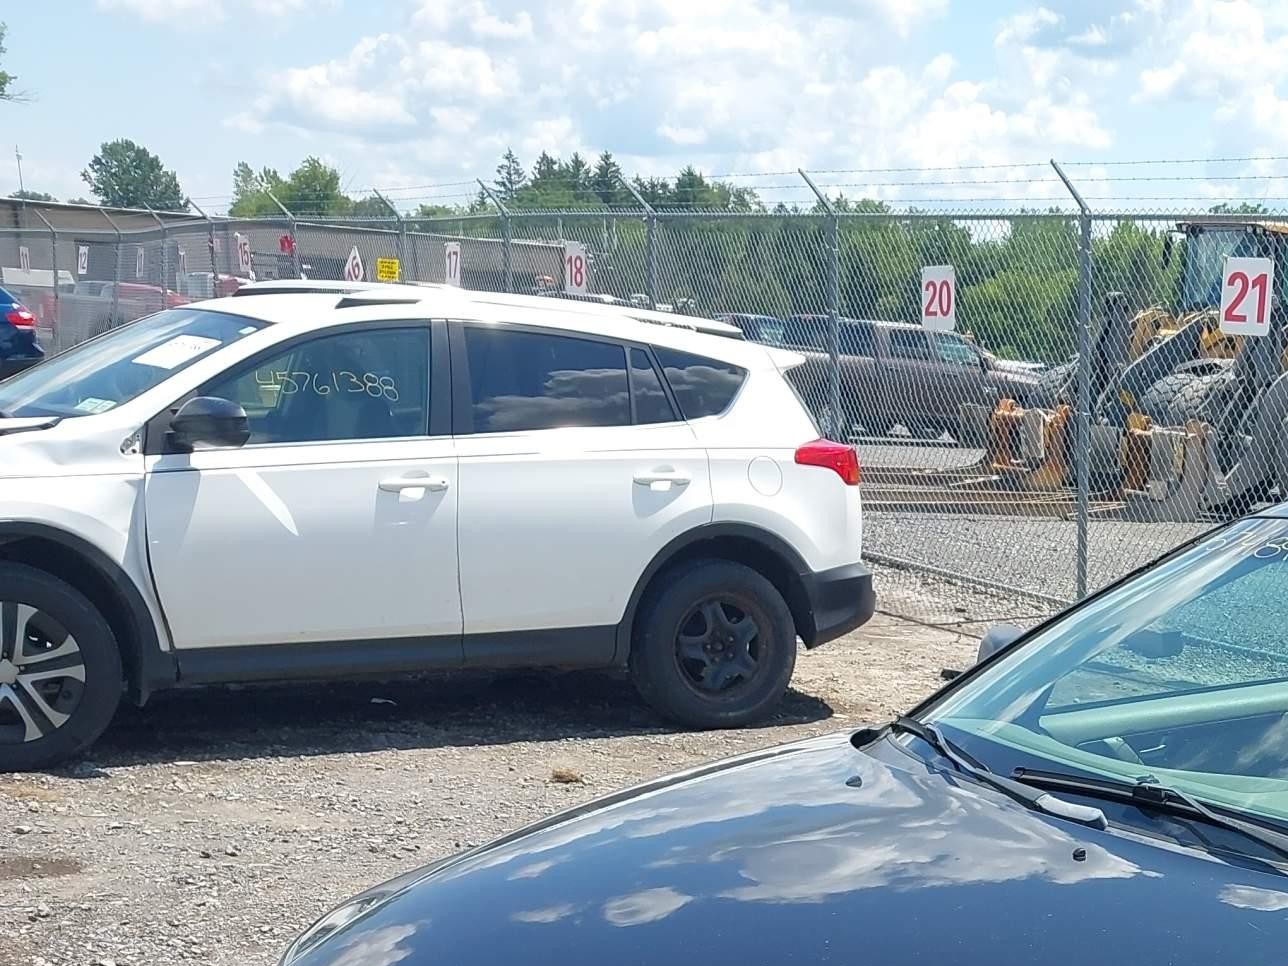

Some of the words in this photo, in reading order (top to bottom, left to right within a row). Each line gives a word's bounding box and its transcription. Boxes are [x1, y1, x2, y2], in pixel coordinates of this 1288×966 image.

[446, 250, 459, 280] 17
[566, 254, 584, 287] 18
[924, 280, 952, 317] 20
[1223, 271, 1269, 325] 21
[255, 370, 399, 402] 45761388
